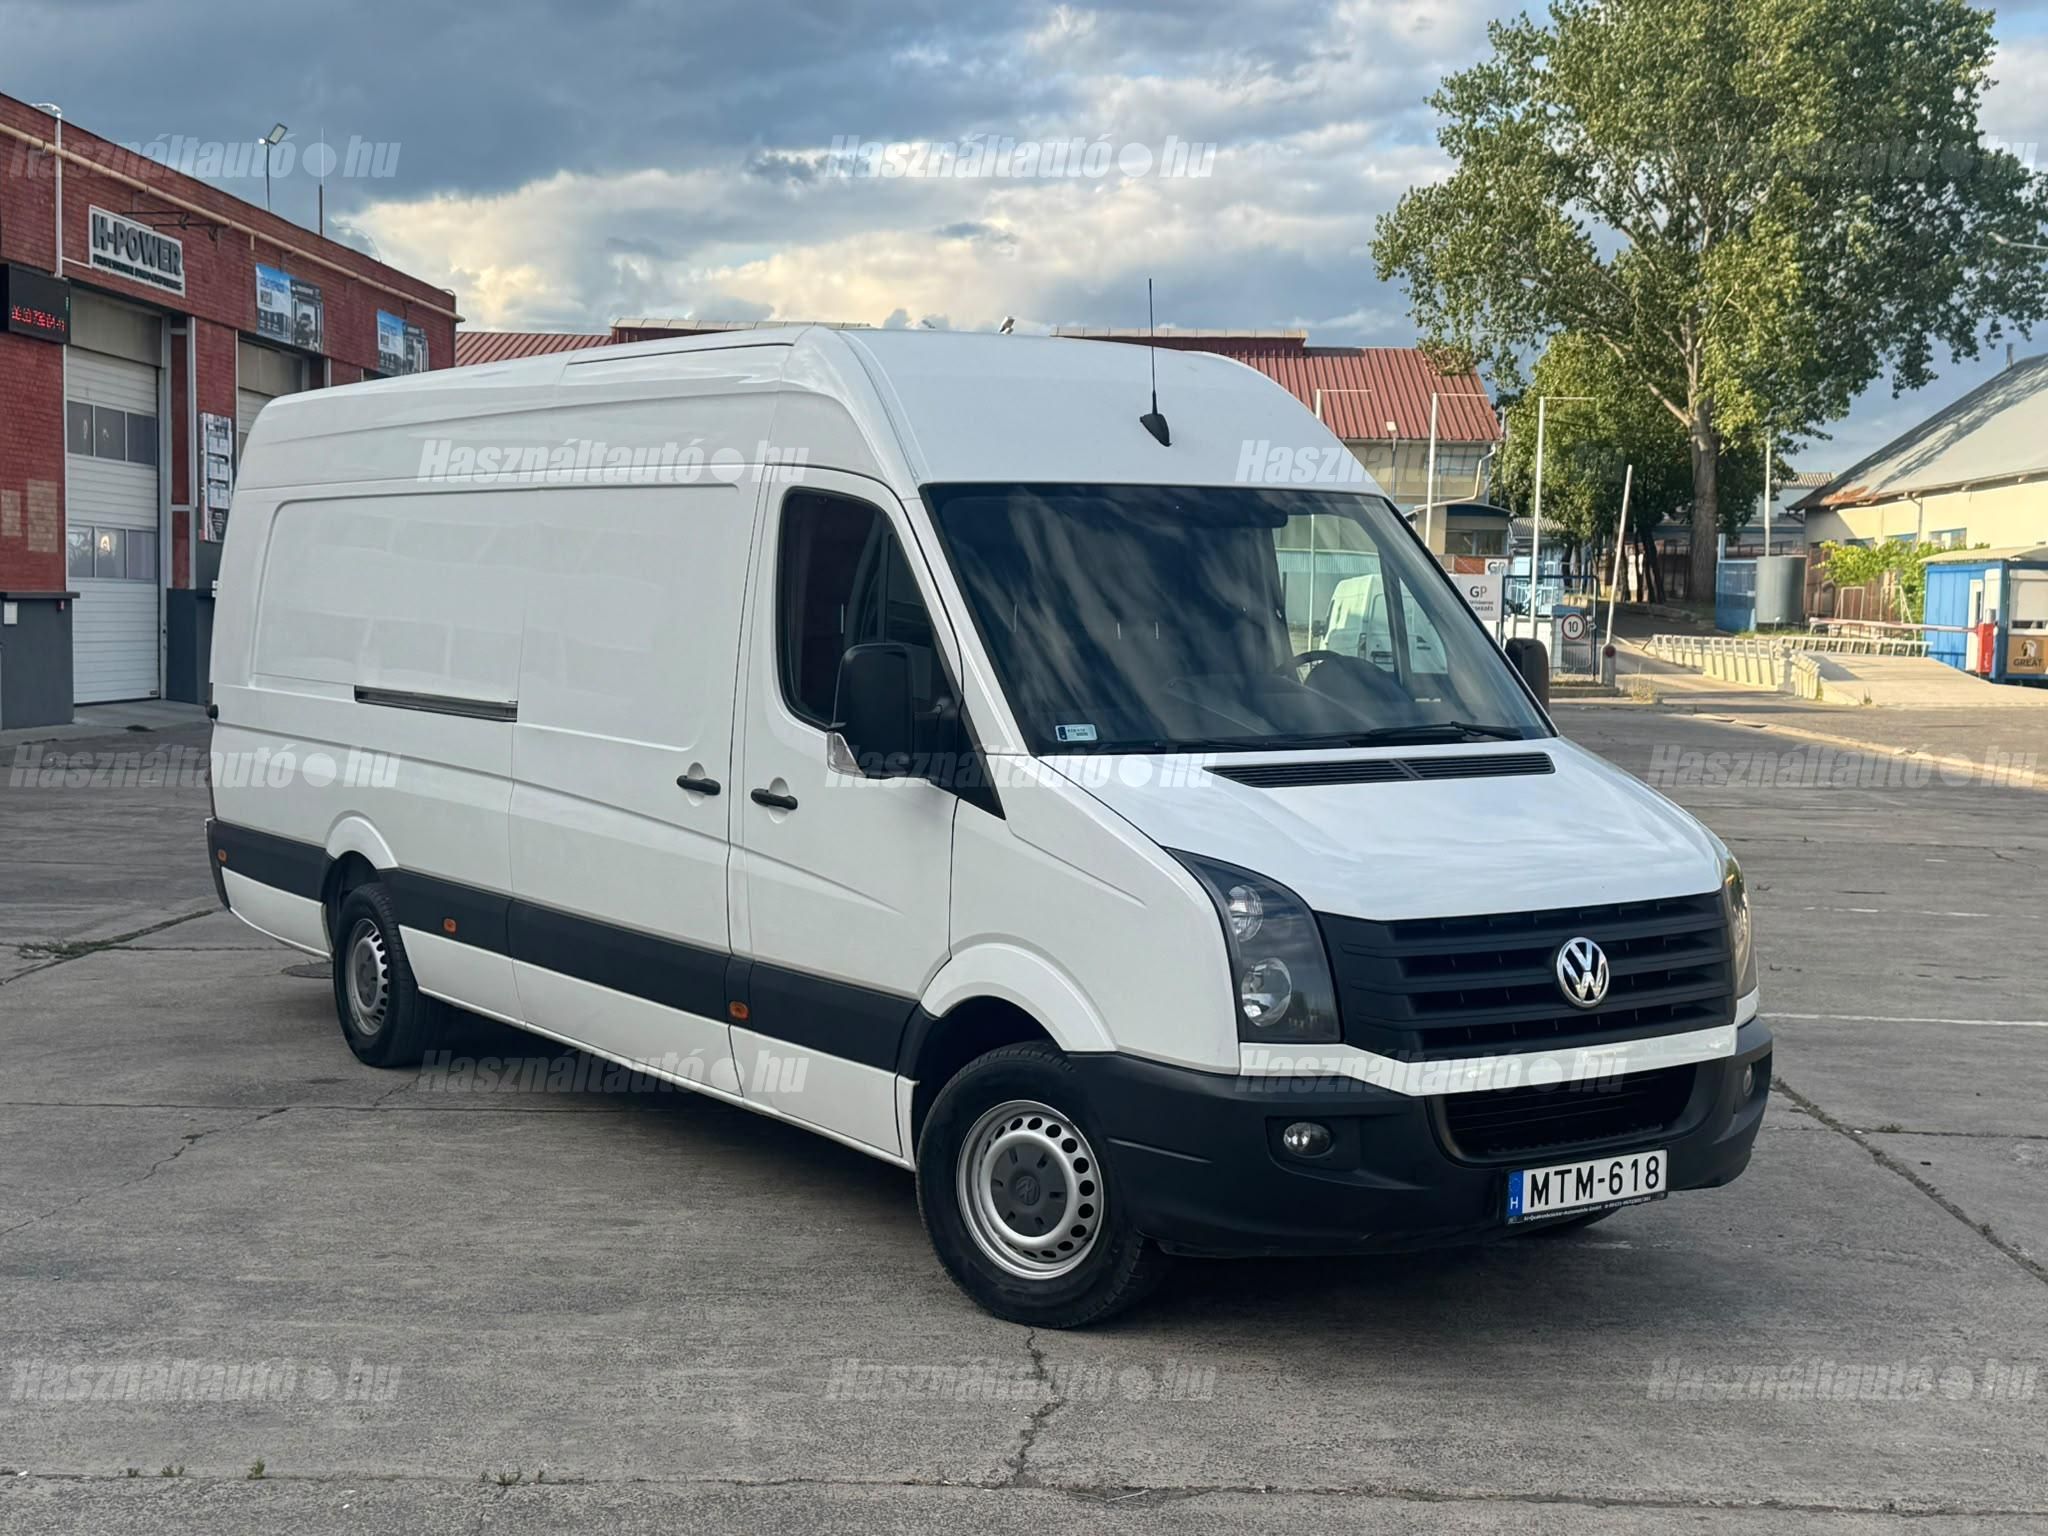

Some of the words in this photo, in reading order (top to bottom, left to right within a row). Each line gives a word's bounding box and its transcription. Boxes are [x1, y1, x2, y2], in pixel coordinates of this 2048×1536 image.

[92, 213, 182, 276] H-POWER
[1469, 585, 1488, 598] GP
[1567, 620, 1579, 633] 10
[2013, 658, 2044, 667] GREAT
[1529, 1155, 1660, 1208] MTM-618
[1510, 1196, 1519, 1210] H
